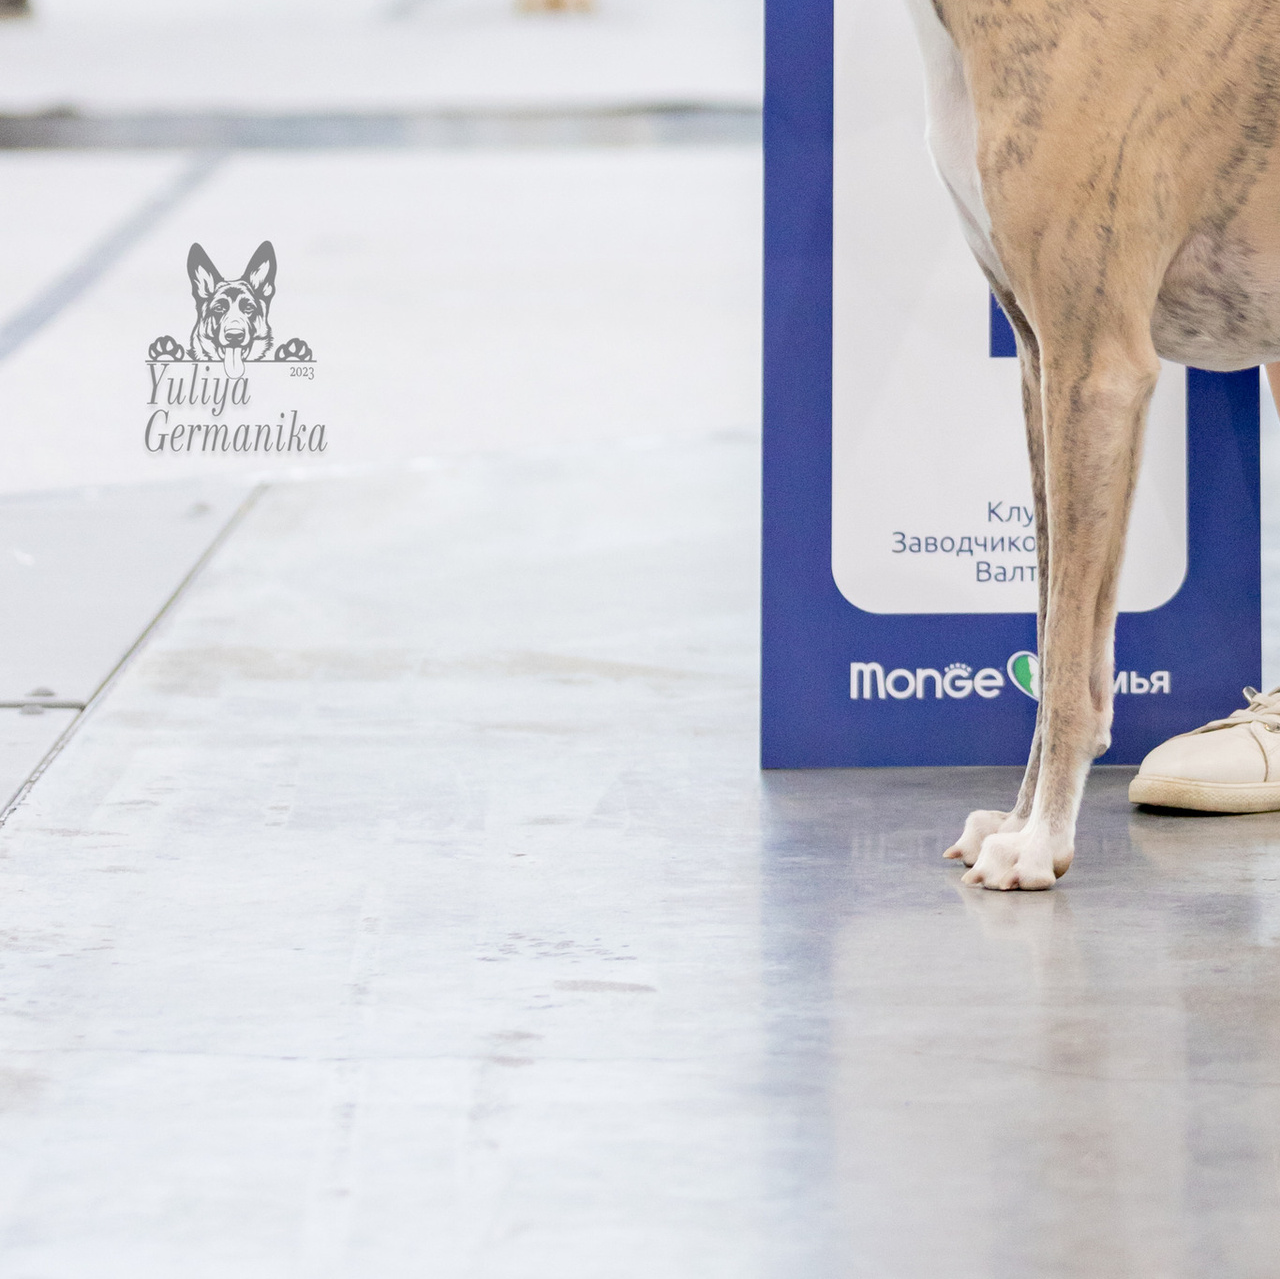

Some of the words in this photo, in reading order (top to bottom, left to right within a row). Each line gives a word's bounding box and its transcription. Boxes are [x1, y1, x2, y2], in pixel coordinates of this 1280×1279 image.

[987, 501, 1034, 528] Клу
[892, 531, 1036, 557] Заводчико
[976, 560, 1037, 583] Валт
[1113, 670, 1171, 694] мья
